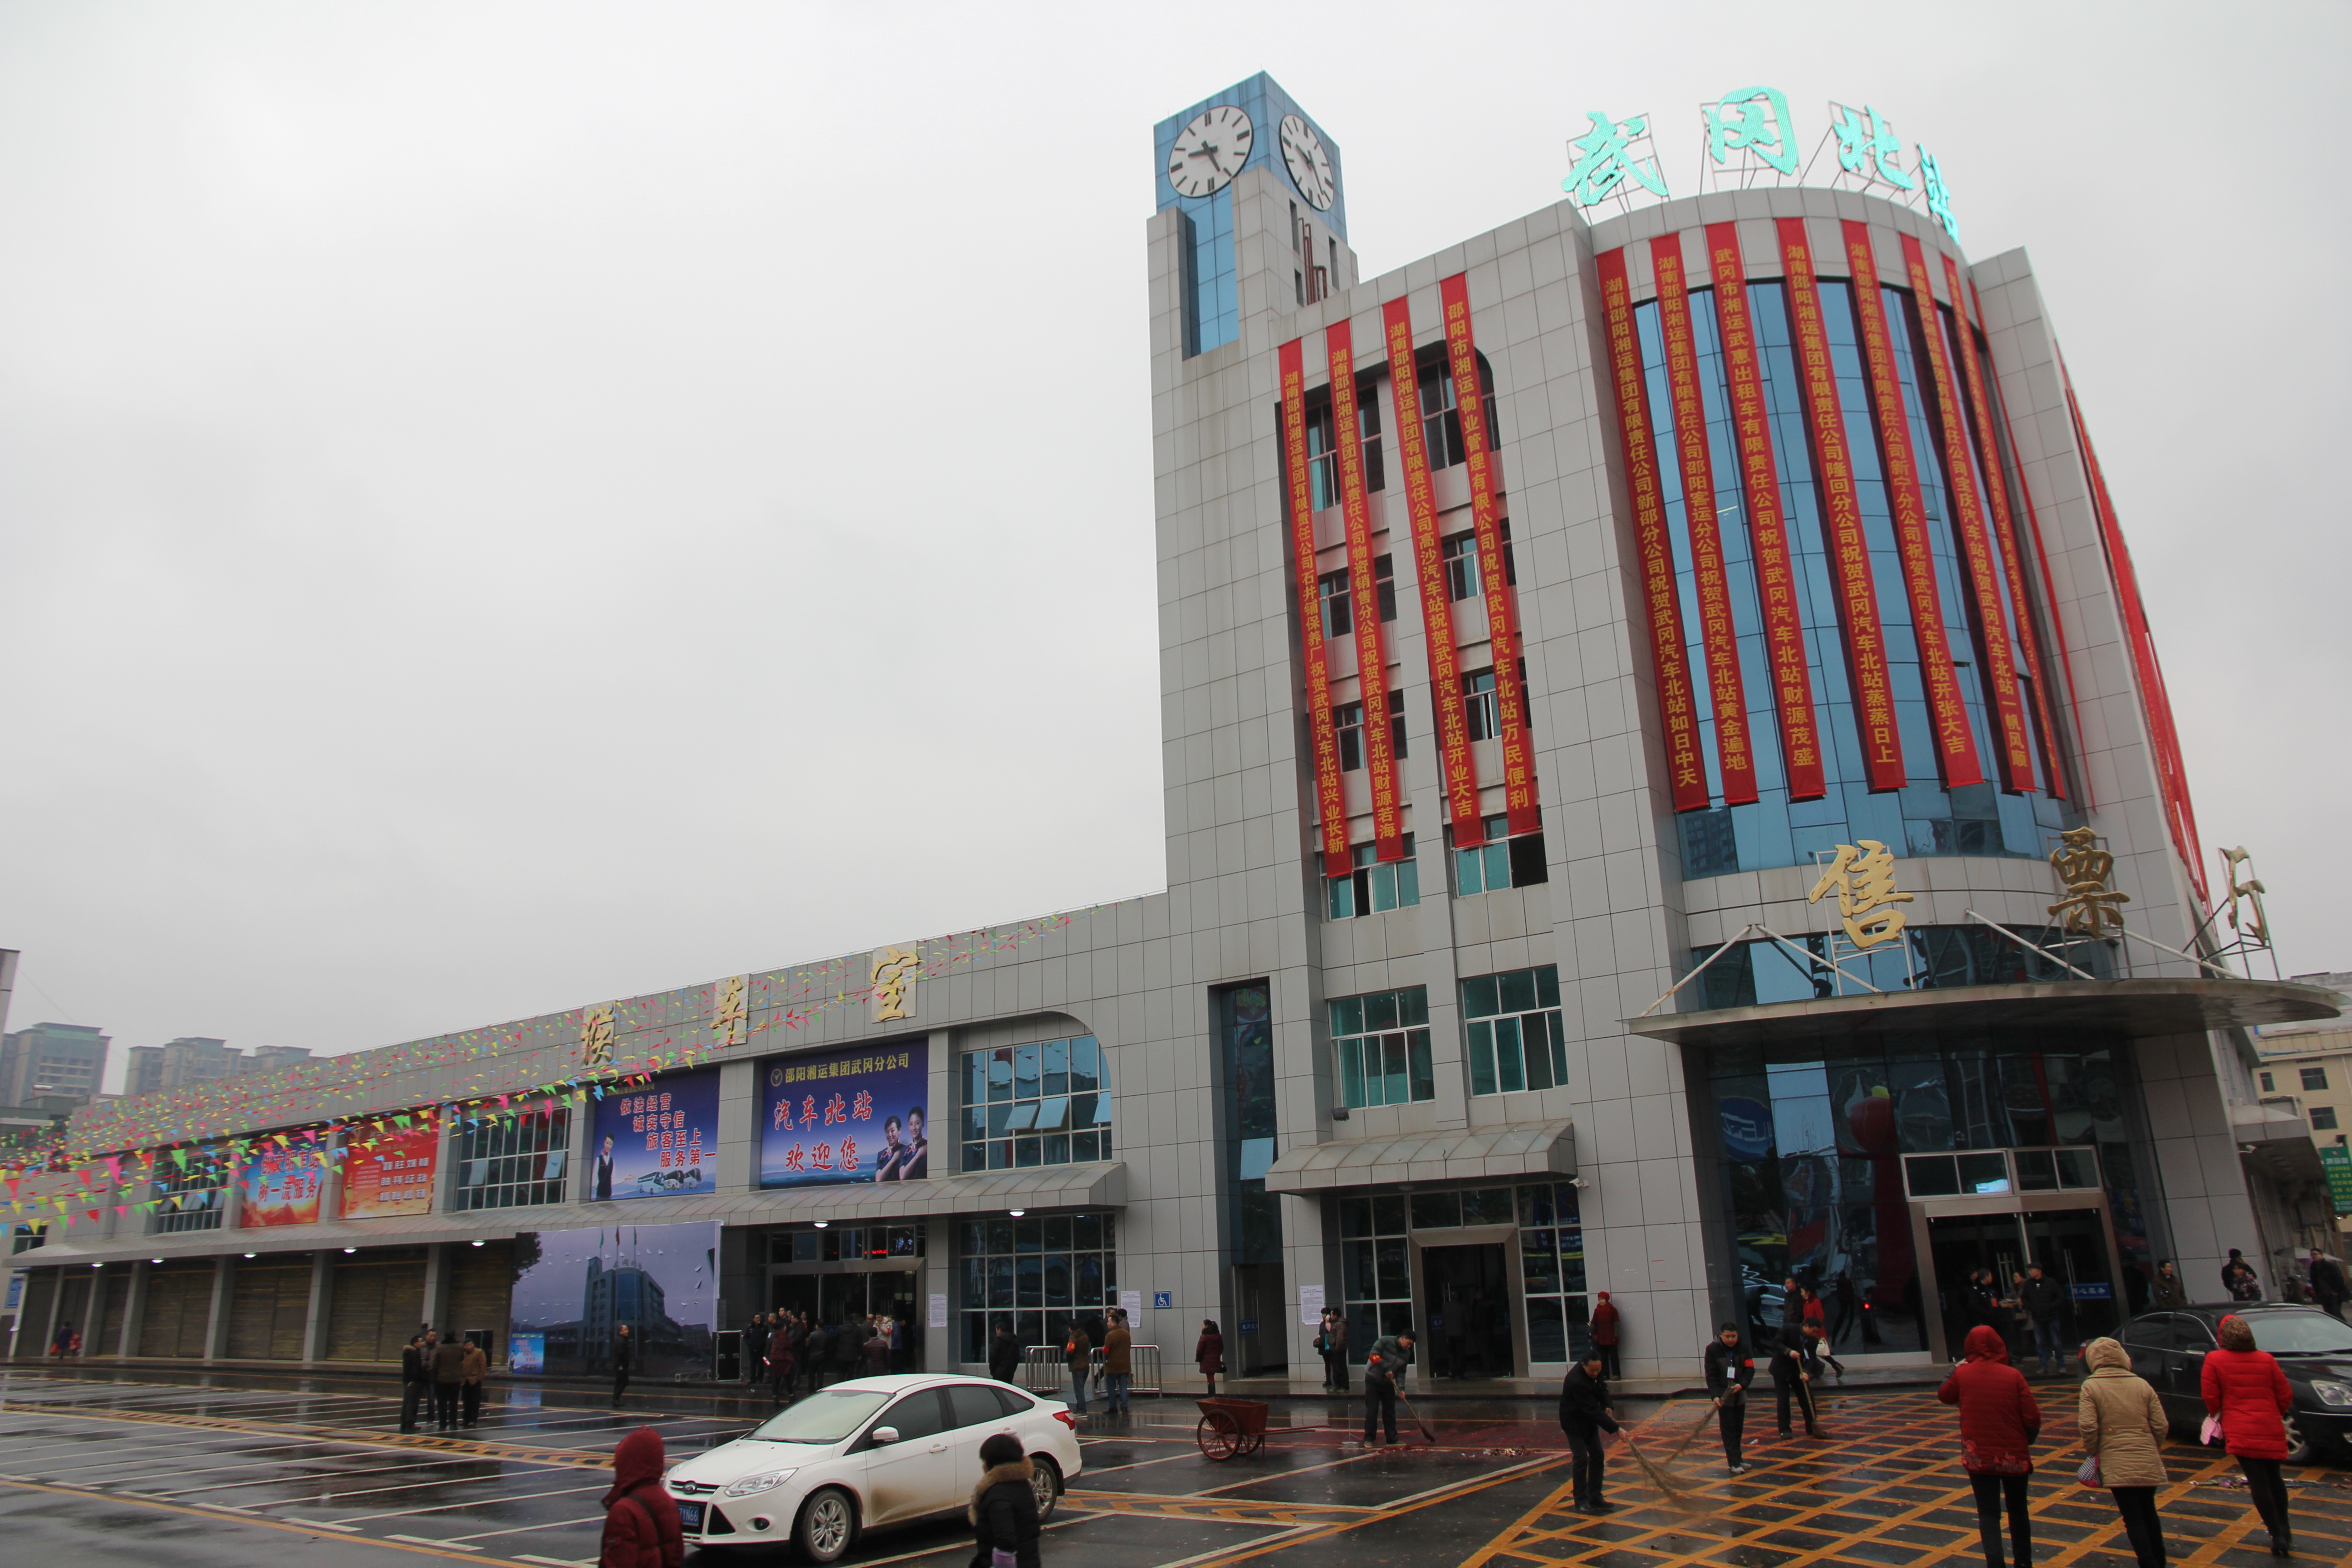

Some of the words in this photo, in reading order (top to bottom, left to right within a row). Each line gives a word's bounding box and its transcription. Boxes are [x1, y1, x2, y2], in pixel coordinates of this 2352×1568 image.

[785, 1053, 909, 1083] 邵阳湘运集团武冈分公司
[620, 1093, 671, 1115] 依法经营
[774, 1090, 872, 1132] 汽车北站
[633, 1110, 685, 1132] 诚实守信
[646, 1128, 702, 1150] 旅客至上
[660, 1148, 716, 1168] 服务第一
[785, 1134, 859, 1173] 欢迎您
